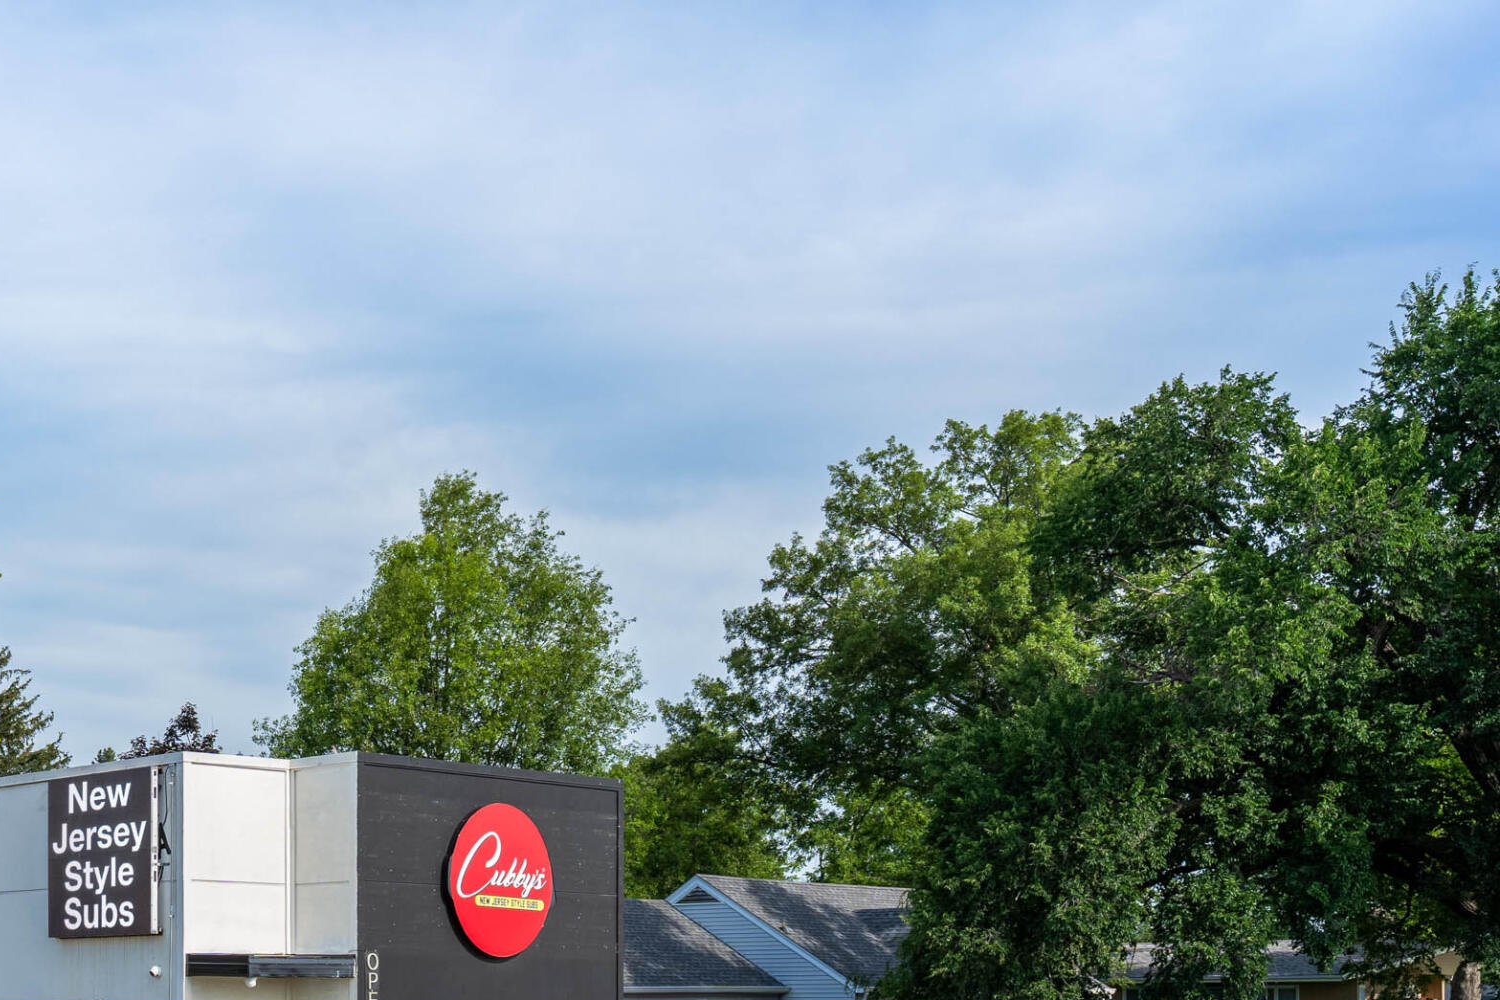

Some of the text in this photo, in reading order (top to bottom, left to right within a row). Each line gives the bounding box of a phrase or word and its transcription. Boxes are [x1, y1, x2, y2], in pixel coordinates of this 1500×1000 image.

[68, 780, 132, 814] New
[52, 820, 147, 855] Jersey
[64, 856, 134, 895] Style
[456, 831, 547, 898] Cubby's
[63, 894, 135, 930] Subs
[479, 896, 491, 905] NEW
[492, 897, 510, 906] JERSEY
[510, 898, 526, 908] STYLE
